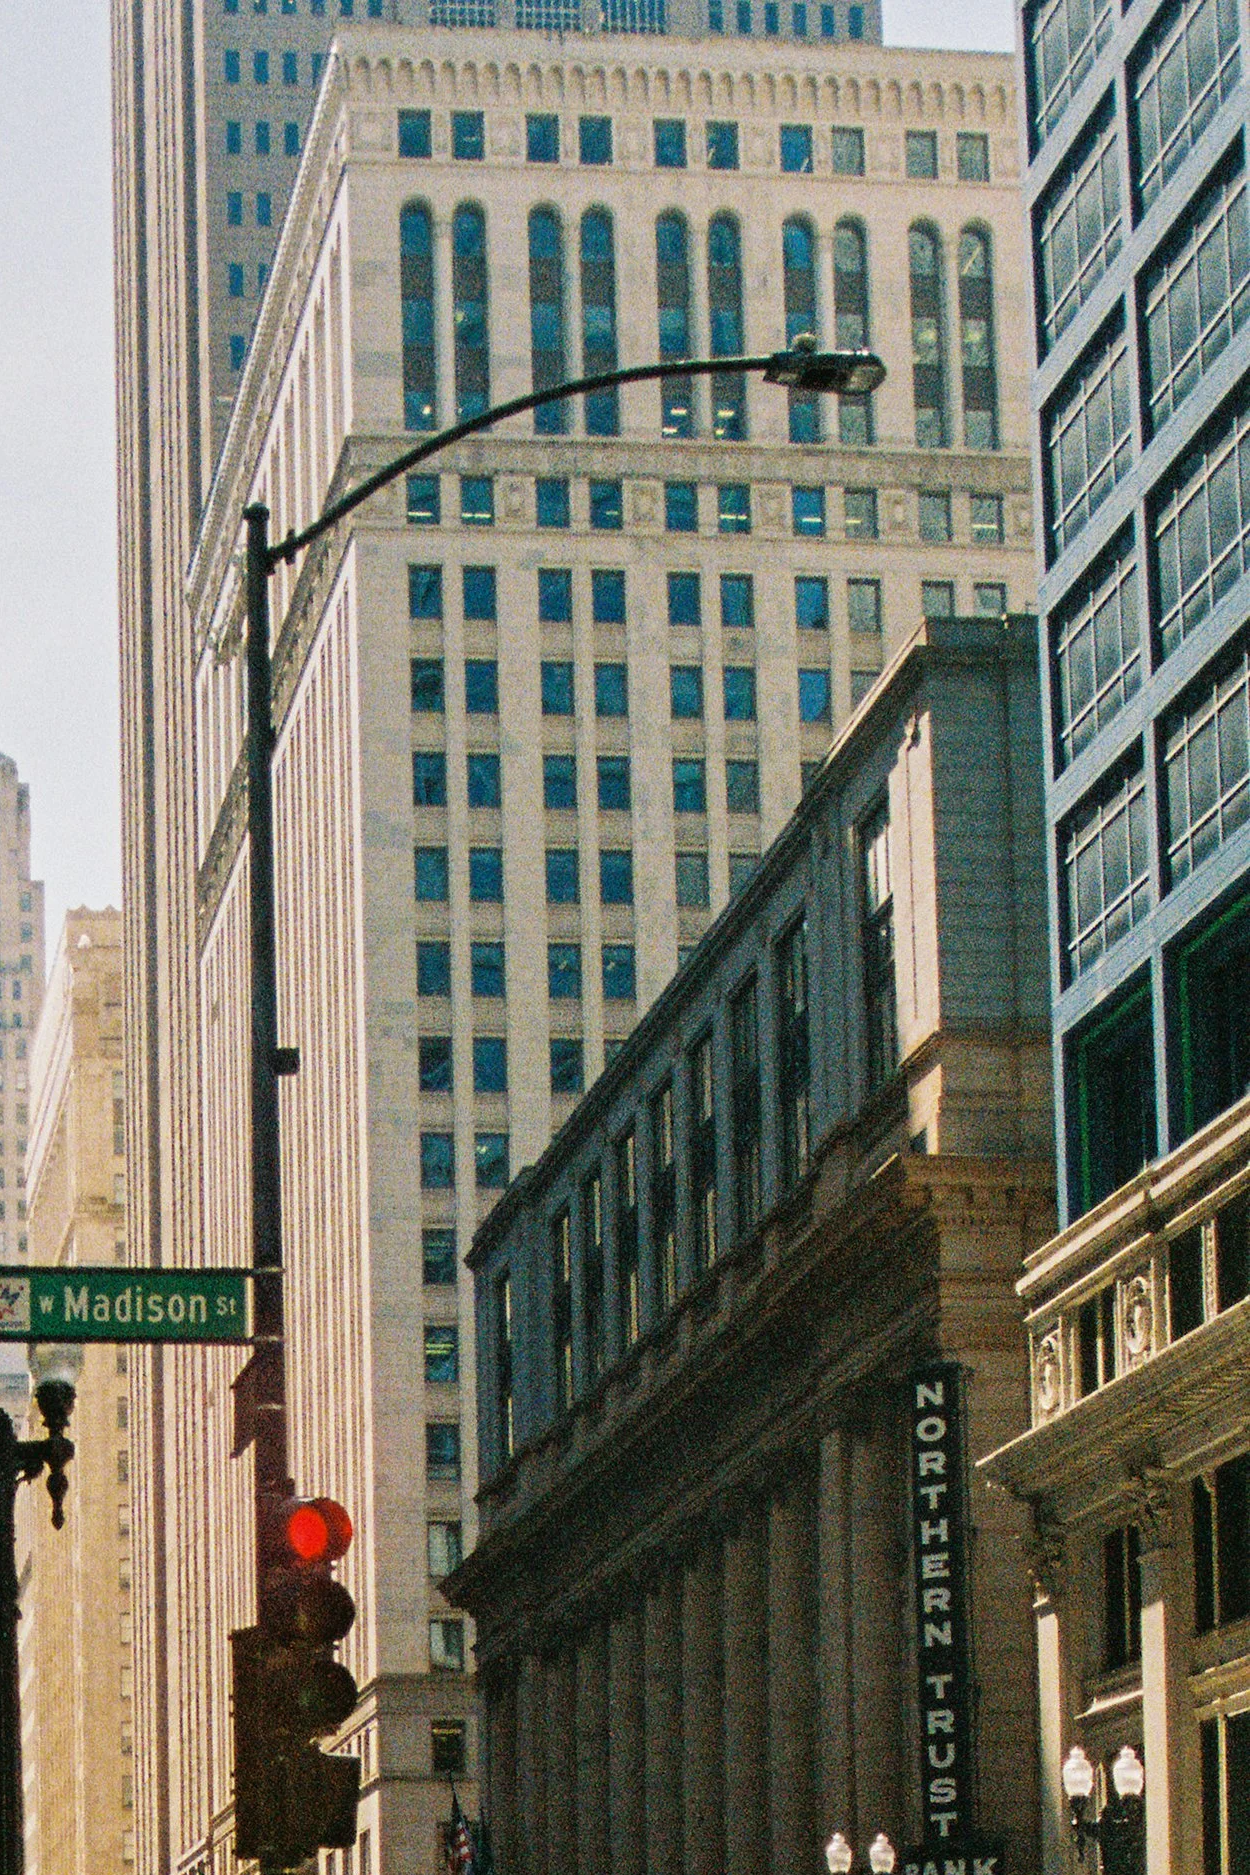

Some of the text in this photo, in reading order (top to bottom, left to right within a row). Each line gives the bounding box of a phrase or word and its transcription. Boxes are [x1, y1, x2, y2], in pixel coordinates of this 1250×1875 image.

[39, 1285, 236, 1323] W Madison St
[915, 1381, 958, 1838] NORTHERN TRUST
